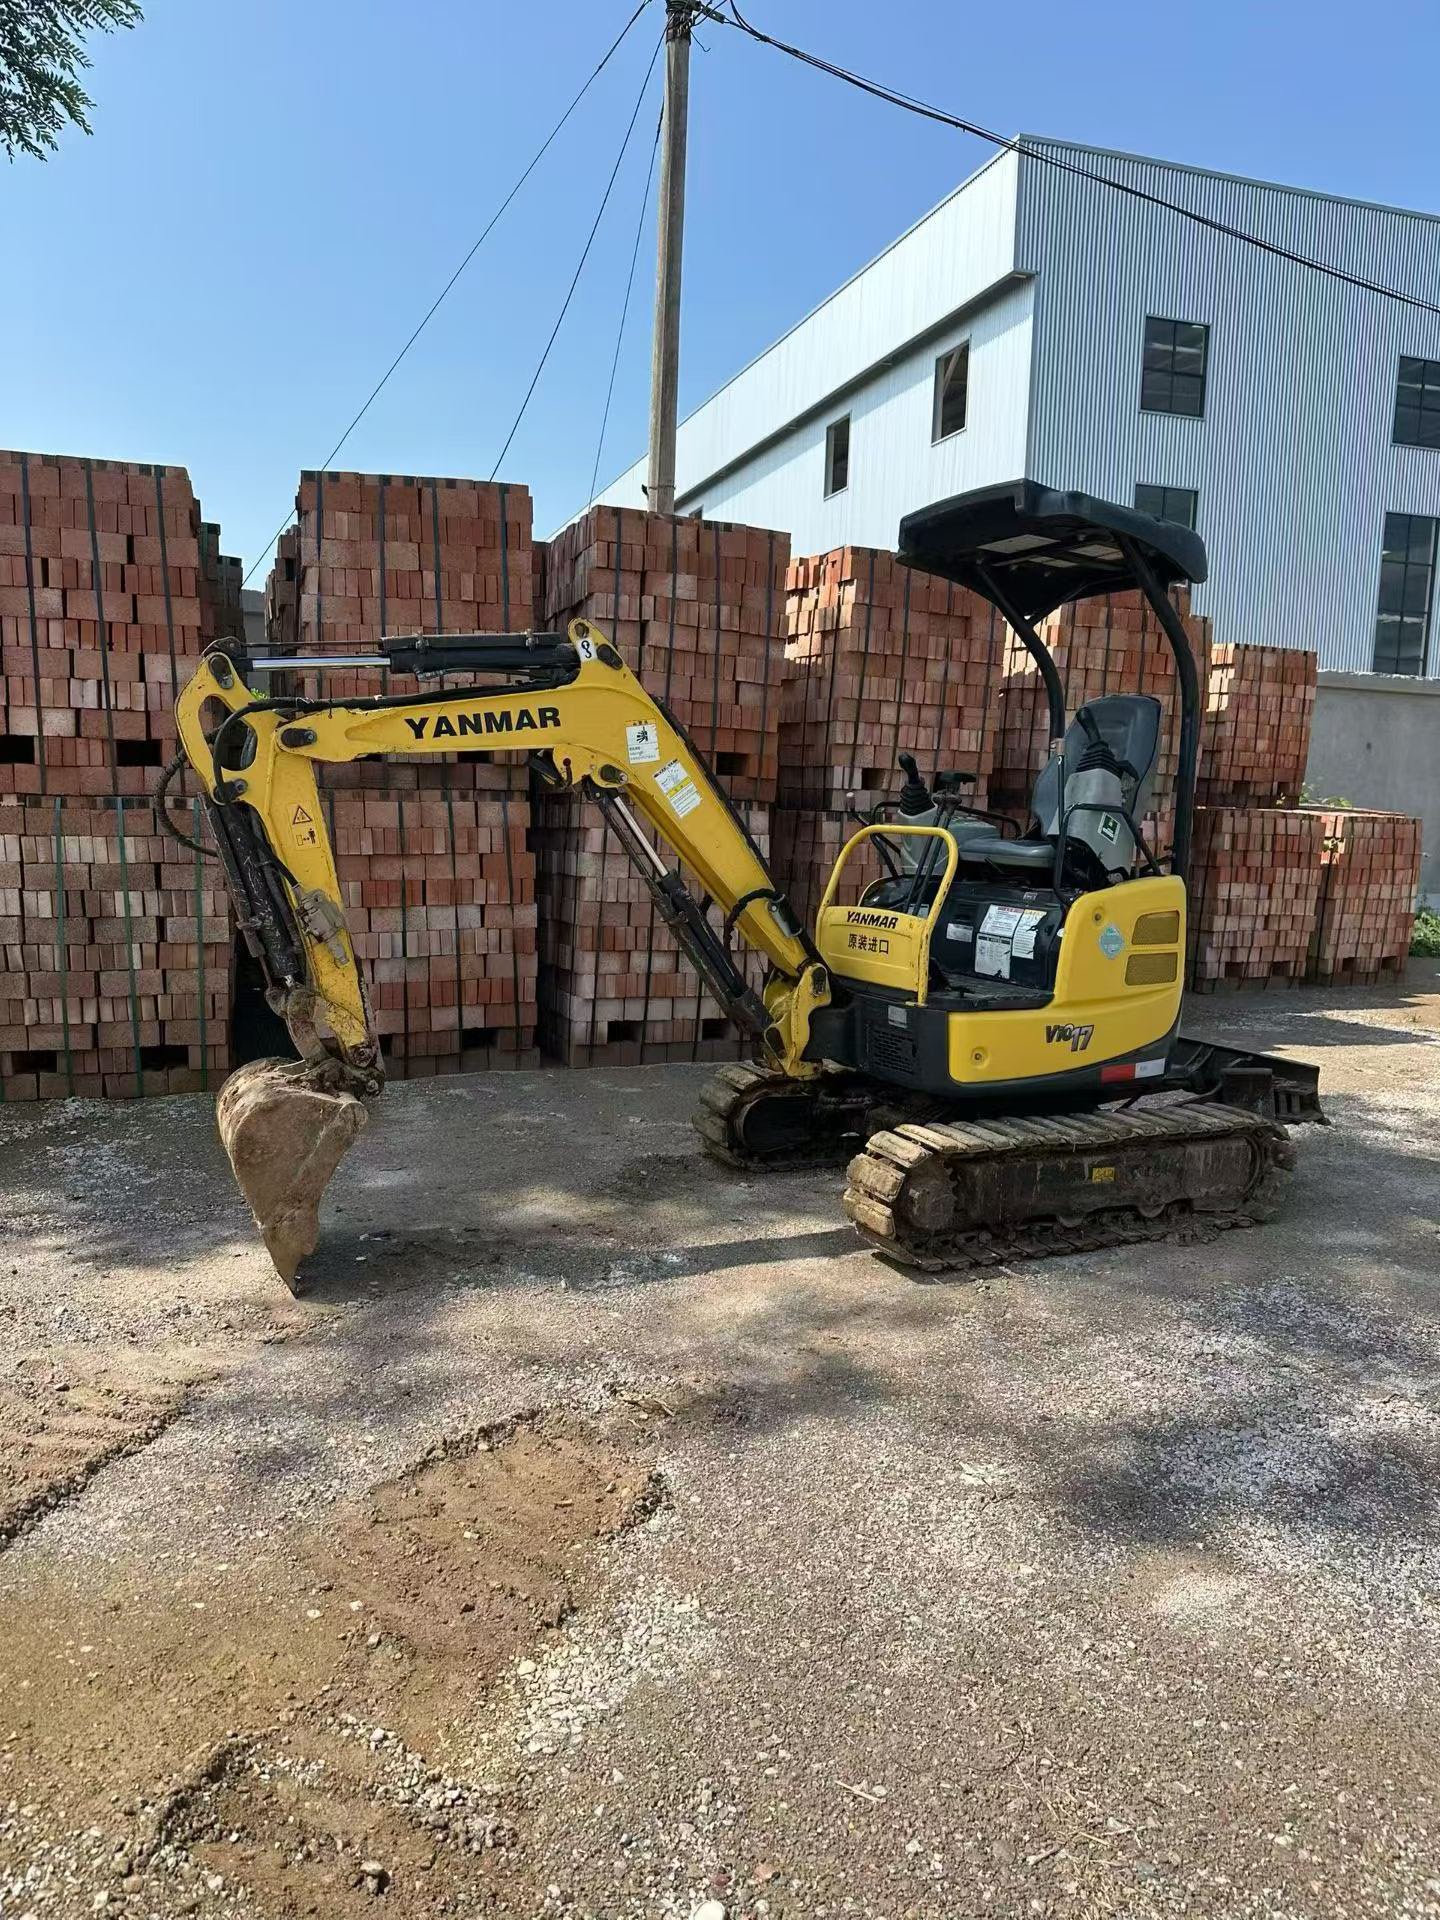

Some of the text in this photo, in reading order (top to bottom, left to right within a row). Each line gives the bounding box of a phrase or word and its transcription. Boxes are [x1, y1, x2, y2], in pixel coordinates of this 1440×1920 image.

[404, 707, 561, 739] YANMAR
[847, 911, 898, 929] YANMAR
[848, 933, 889, 954] 原装进口
